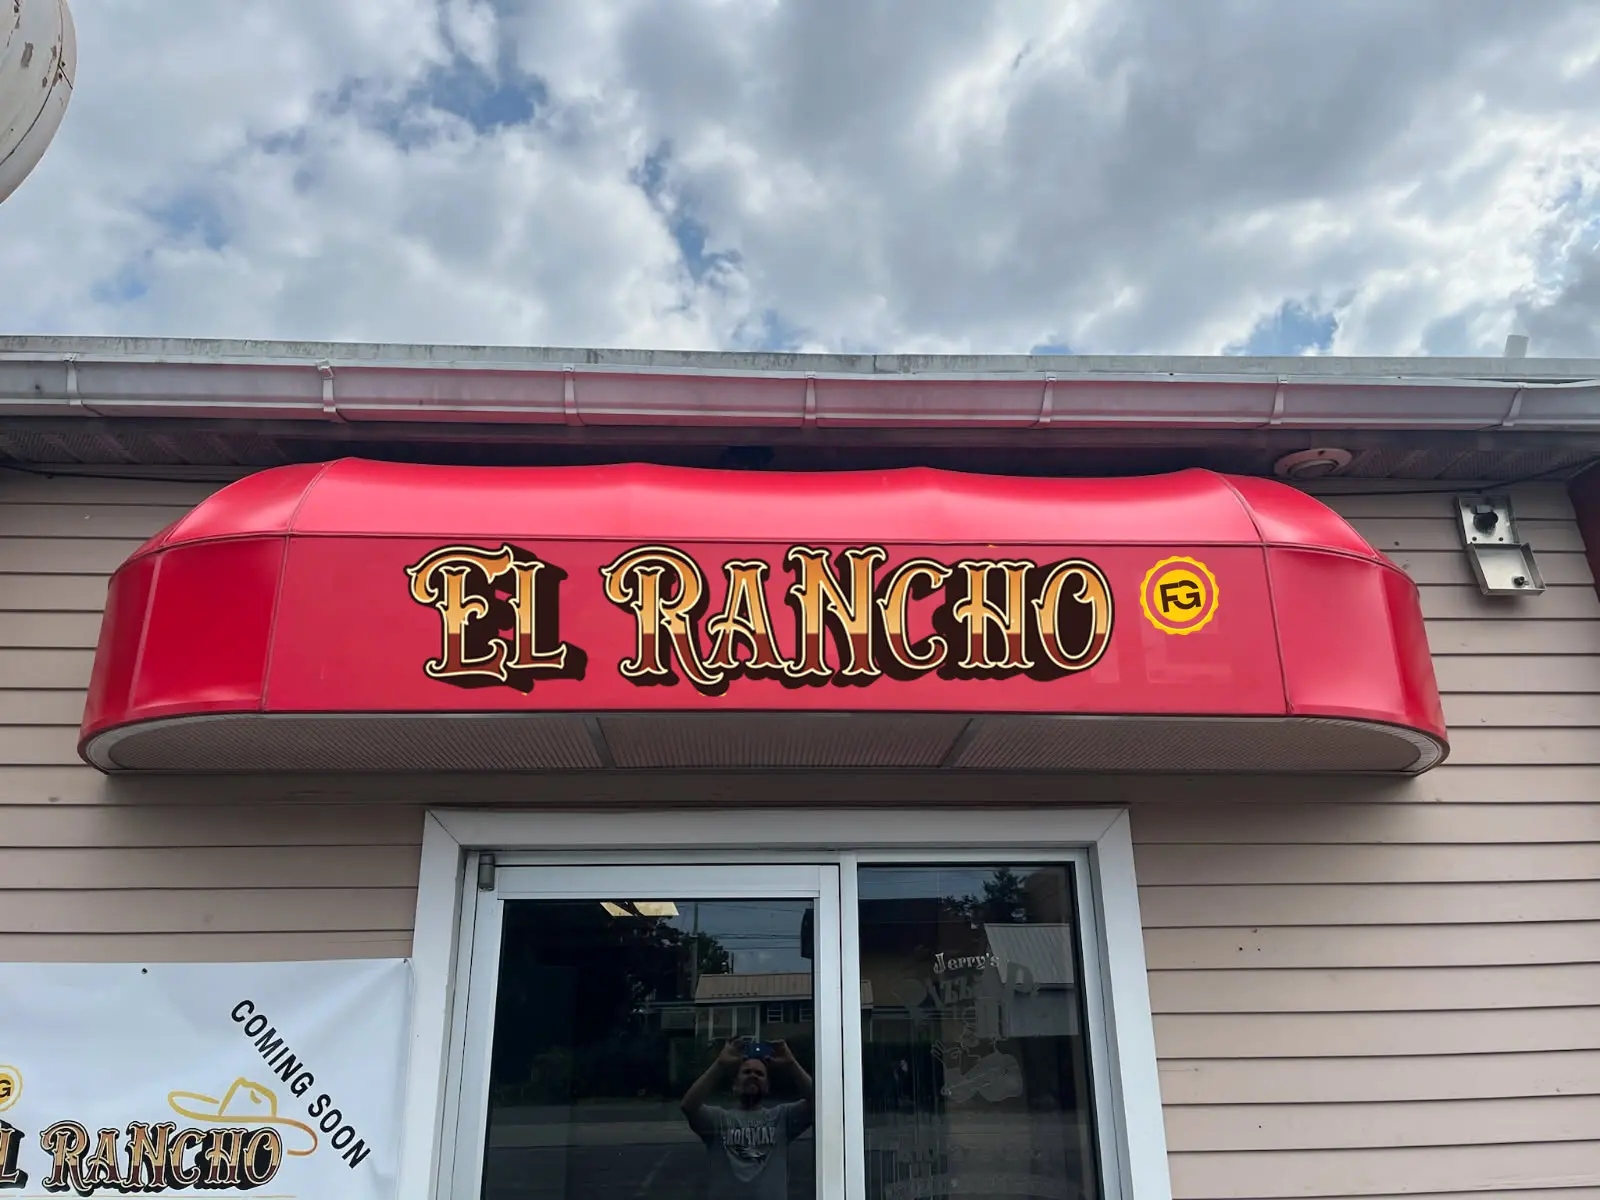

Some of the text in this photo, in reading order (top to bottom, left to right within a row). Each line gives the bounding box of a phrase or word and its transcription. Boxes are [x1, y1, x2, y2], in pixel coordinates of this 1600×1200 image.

[404, 543, 1115, 695] EL RANCHO
[1160, 580, 1201, 613] FG
[933, 952, 1000, 974] Jerry's
[230, 999, 371, 1169] COMING SOON
[0, 1119, 282, 1197] L RANCHO
